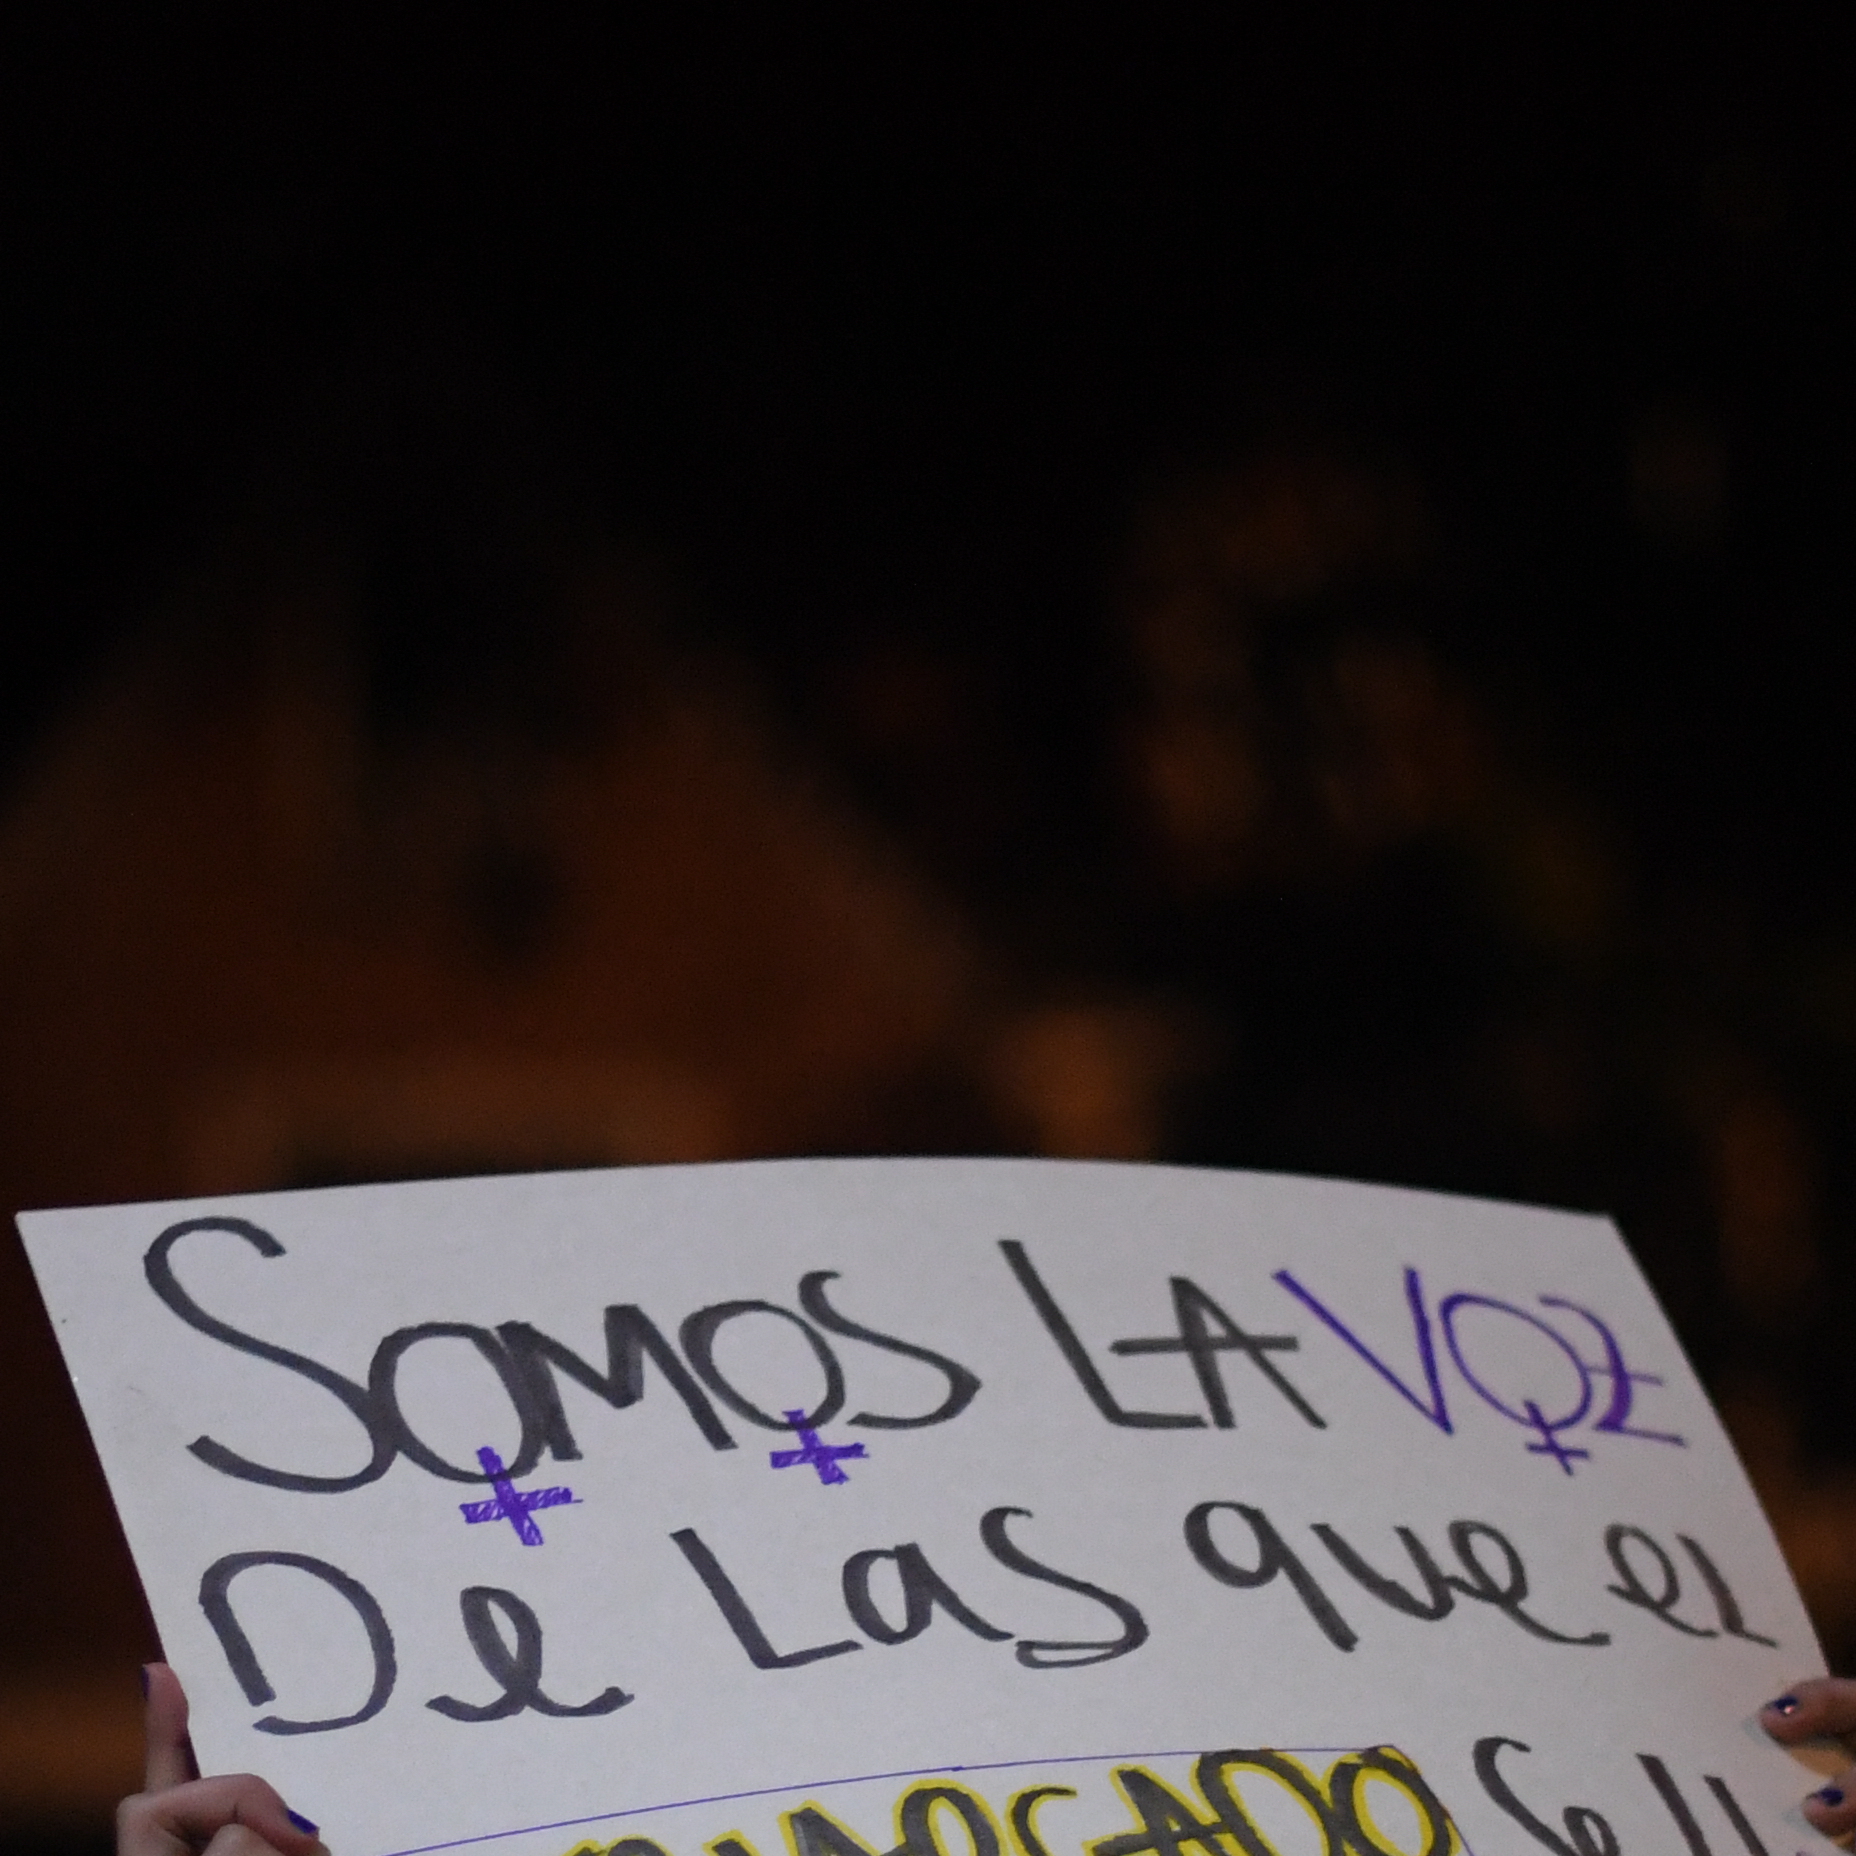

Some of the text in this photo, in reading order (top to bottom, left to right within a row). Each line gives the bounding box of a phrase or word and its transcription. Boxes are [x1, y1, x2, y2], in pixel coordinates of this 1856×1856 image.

[999, 1239, 1327, 1430] LA
[1272, 1264, 1688, 1476] VOZ
[198, 1550, 635, 1736] De
[1183, 1500, 1611, 1653] que
